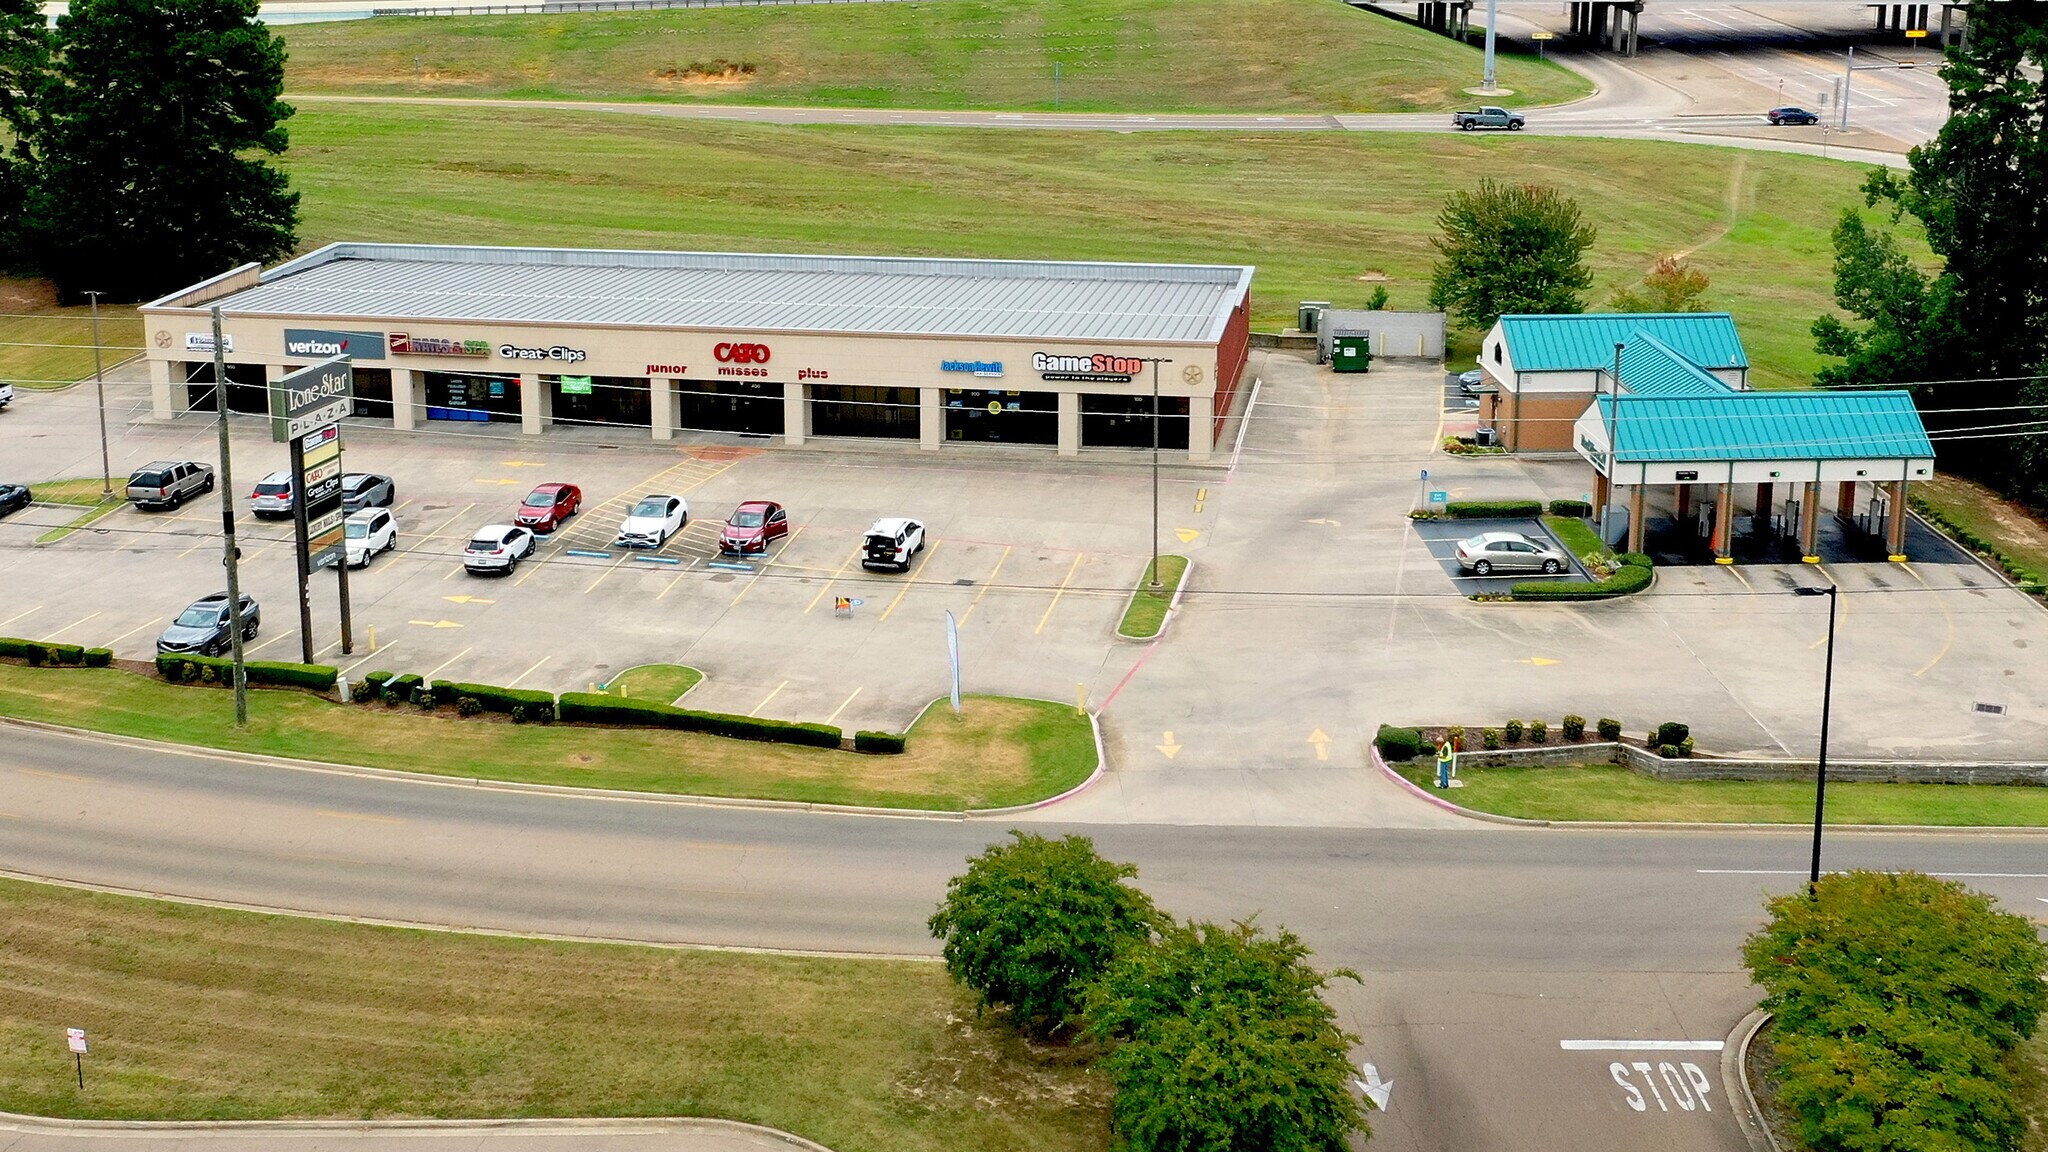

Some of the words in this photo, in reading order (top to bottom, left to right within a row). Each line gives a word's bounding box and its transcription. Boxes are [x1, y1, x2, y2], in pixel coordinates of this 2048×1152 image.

[288, 340, 341, 355] verizon
[412, 338, 450, 354] NAILS
[463, 340, 491, 356] SPA
[499, 345, 544, 359] Great
[548, 346, 585, 363] Clips
[714, 342, 771, 364] CATO
[646, 364, 688, 374] junior
[718, 367, 769, 377] misses
[1032, 352, 1142, 375] GameStop
[798, 368, 829, 380] plus
[289, 384, 322, 411] Lone
[320, 372, 348, 398] Star
[306, 468, 323, 484] CATO
[307, 485, 325, 497] Great
[325, 478, 339, 489] Clips
[317, 552, 337, 567] verizon
[1609, 1062, 1712, 1112] STOP
